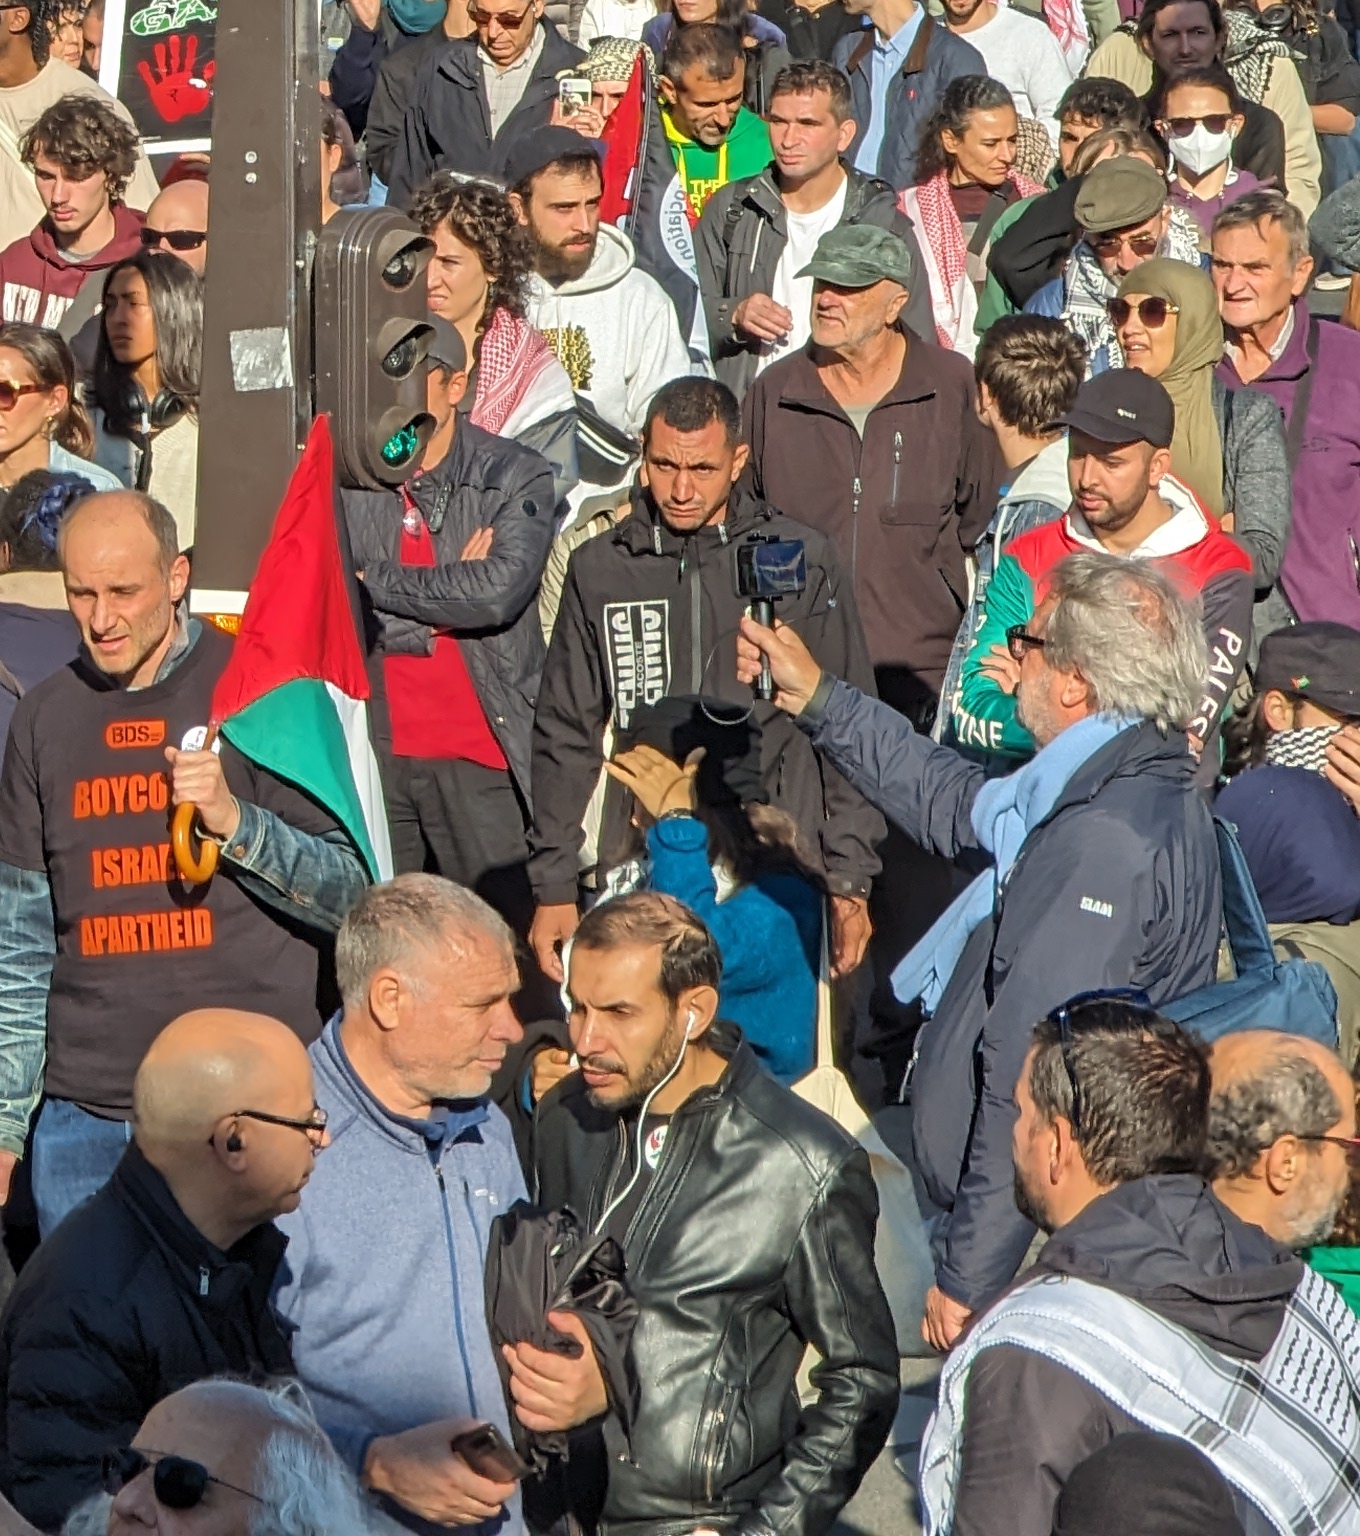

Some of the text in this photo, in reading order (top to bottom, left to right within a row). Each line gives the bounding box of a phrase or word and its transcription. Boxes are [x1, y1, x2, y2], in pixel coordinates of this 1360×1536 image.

[635, 641, 645, 697] LACOSTE
[112, 725, 150, 744] BDS
[74, 772, 168, 819] BOYCO
[80, 908, 213, 956] APARTHEID
